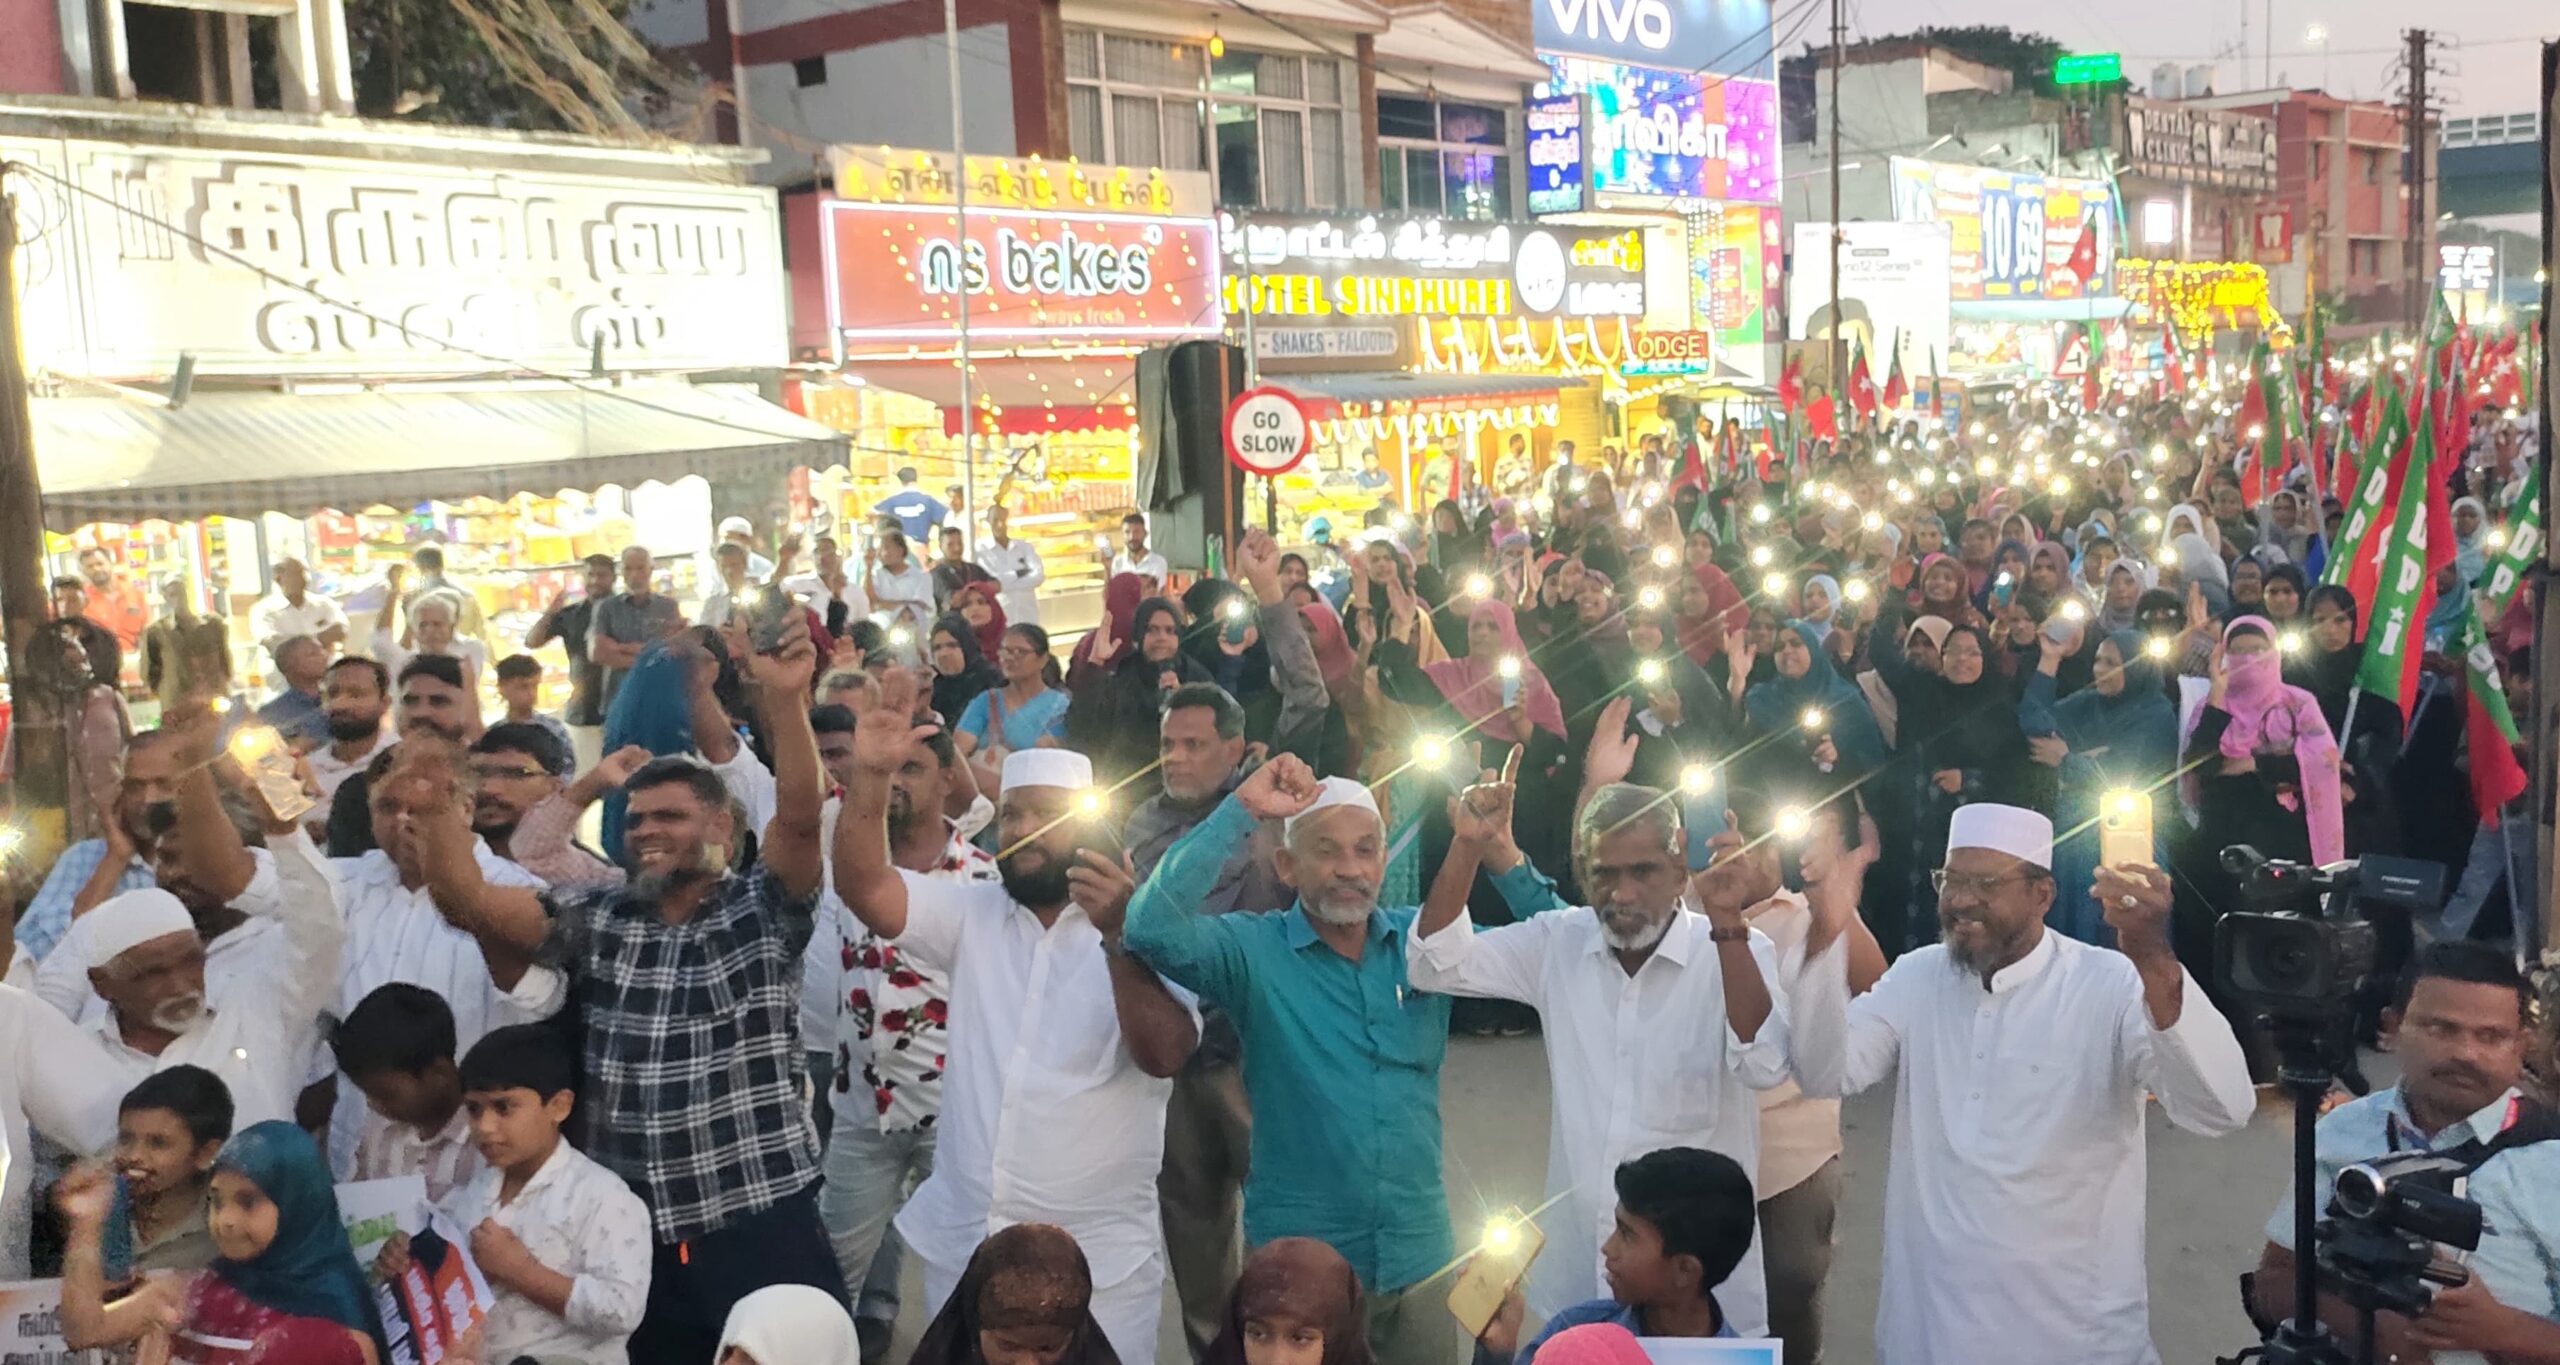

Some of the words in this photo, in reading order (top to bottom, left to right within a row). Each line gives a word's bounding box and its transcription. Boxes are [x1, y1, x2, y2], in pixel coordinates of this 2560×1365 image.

[922, 238, 989, 295] ns
[1001, 228, 1151, 296] bakes
[1271, 331, 1325, 354] SHAKES
[1337, 331, 1395, 353] FALOODA
[1629, 335, 1701, 358] ODGE
[1252, 410, 1280, 431] GO
[1241, 434, 1296, 455] SLOW
